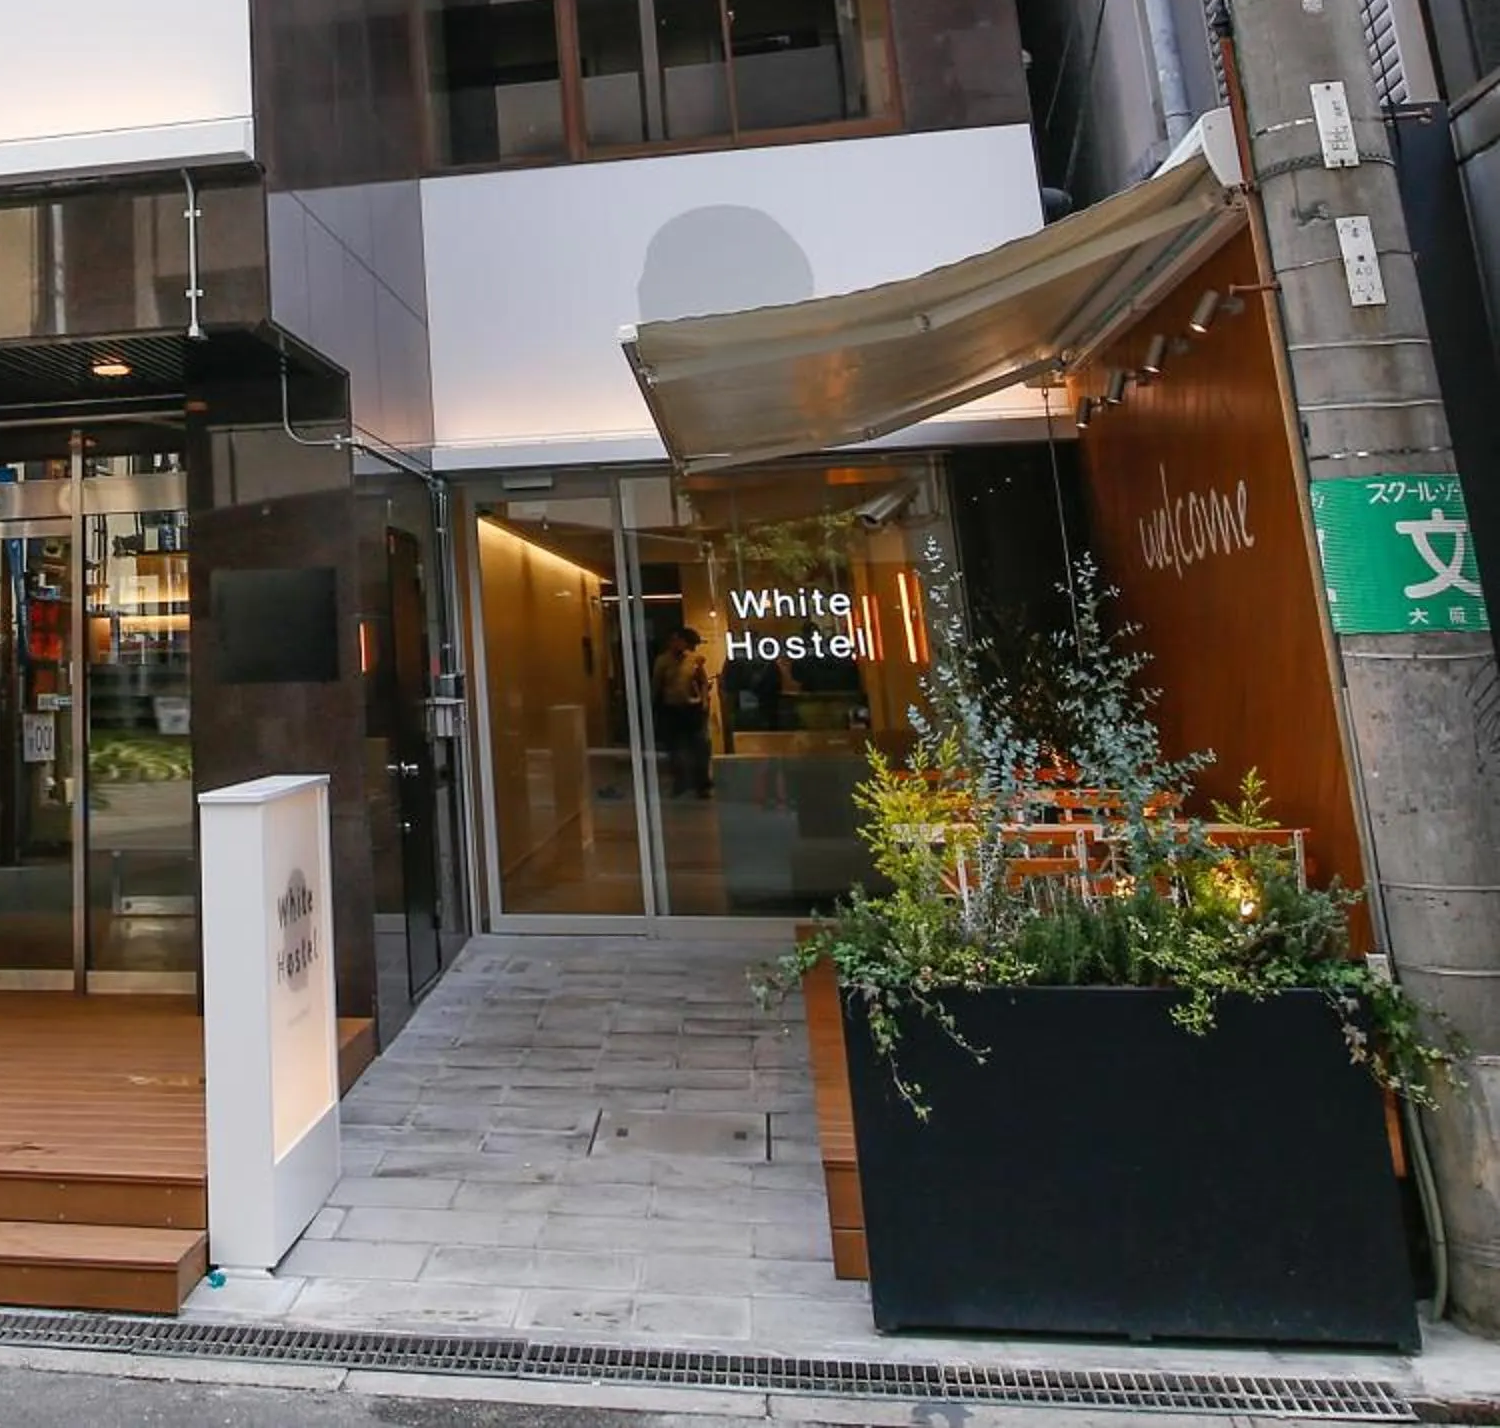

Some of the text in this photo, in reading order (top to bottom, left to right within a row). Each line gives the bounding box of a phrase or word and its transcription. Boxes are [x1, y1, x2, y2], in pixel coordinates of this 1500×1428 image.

[1139, 463, 1255, 579] welcome
[730, 587, 852, 619] White
[725, 627, 870, 662] Hostel
[277, 886, 313, 929] White
[277, 926, 319, 985] Hostel
